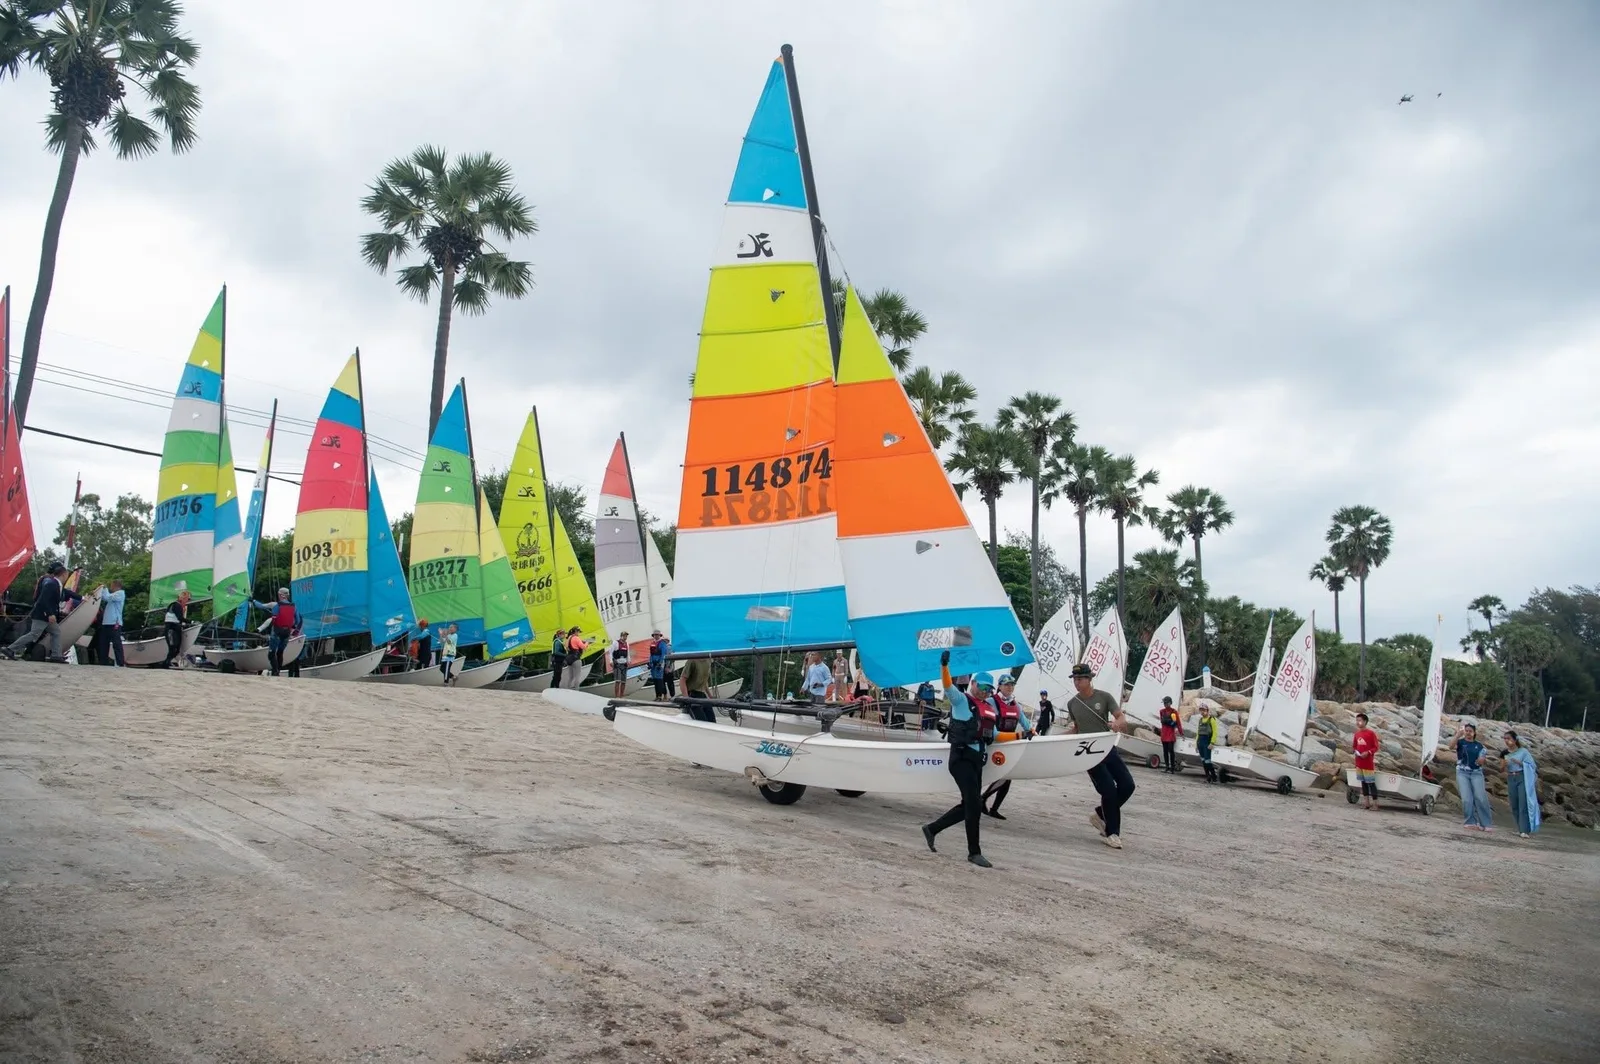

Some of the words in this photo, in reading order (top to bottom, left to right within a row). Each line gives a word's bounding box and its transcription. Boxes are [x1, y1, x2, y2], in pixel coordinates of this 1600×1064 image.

[701, 447, 832, 497] 114874
[155, 496, 203, 524] 117756
[412, 558, 468, 581] 112277
[599, 588, 642, 611] 114217
[1036, 639, 1061, 662] 1953
[1087, 646, 1107, 667] 1901
[1148, 650, 1172, 674] 1223
[756, 740, 794, 757] Hobie
[914, 758, 944, 766] PTTEP
